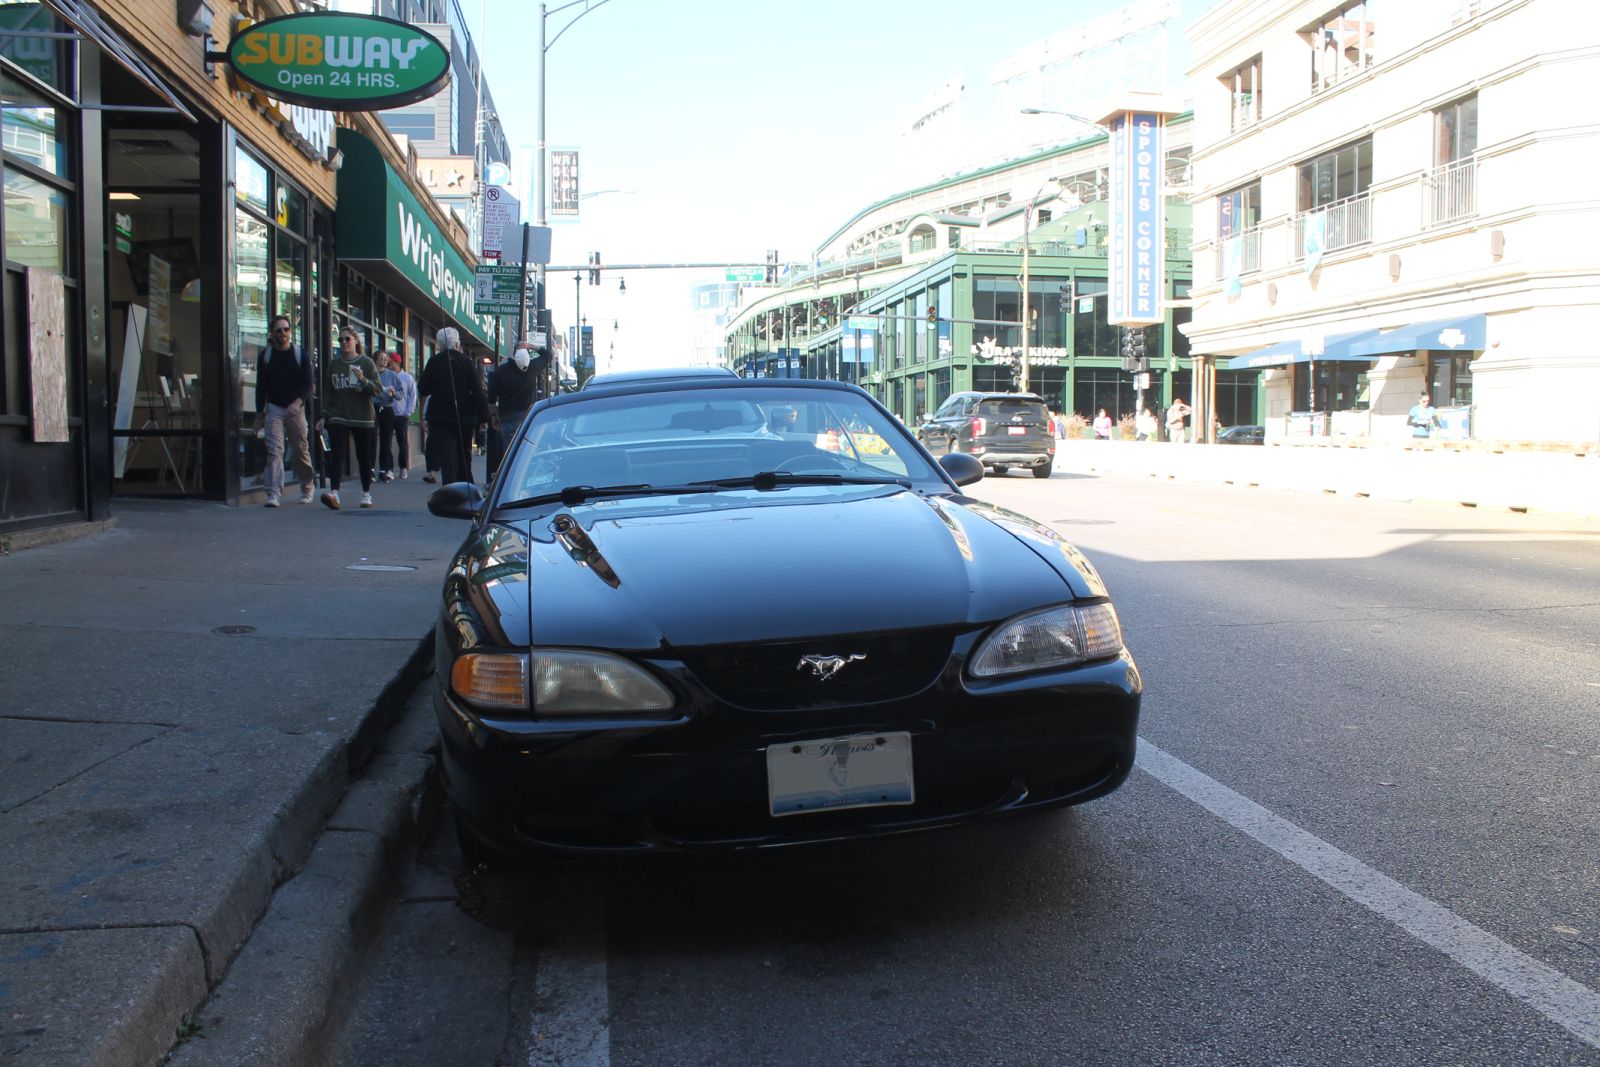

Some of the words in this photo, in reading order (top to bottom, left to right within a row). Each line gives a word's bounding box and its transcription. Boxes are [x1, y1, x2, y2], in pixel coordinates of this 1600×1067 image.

[236, 32, 431, 70] SUBWAY
[277, 69, 324, 88] Open
[329, 71, 351, 86] 24
[357, 73, 400, 88] HRS.
[1137, 121, 1152, 211] SPORTS
[1137, 222, 1151, 312] CORNER
